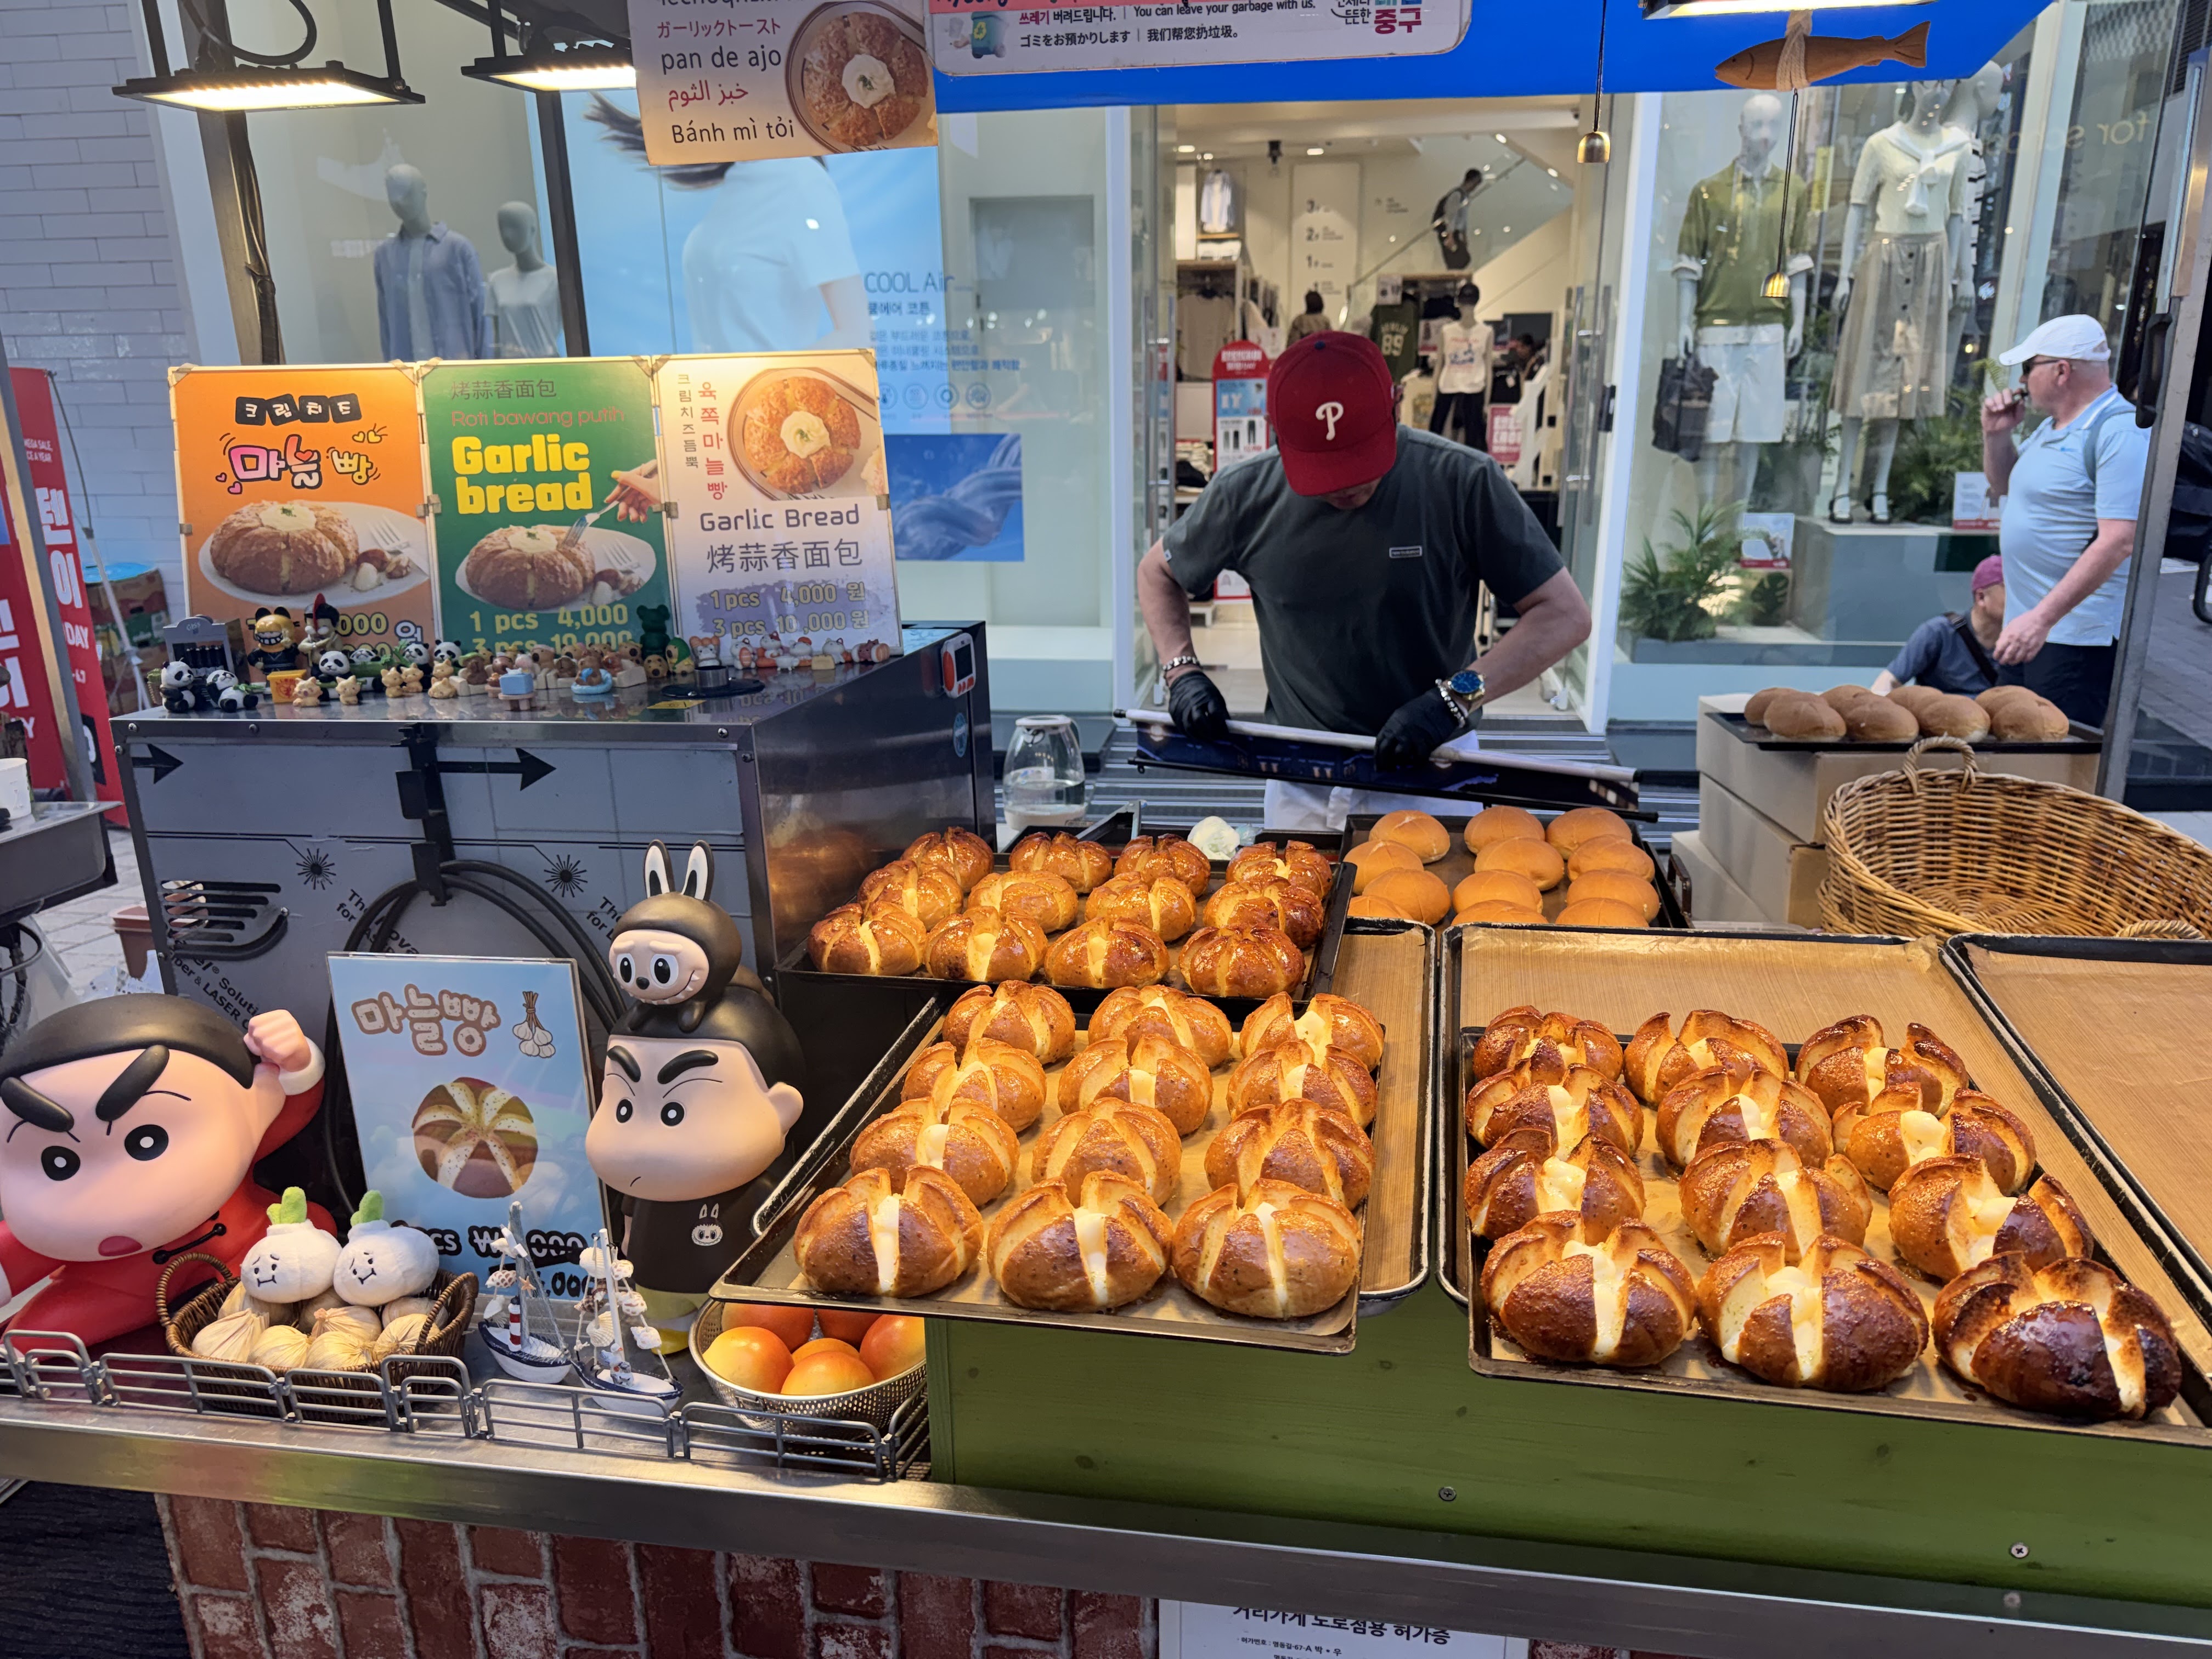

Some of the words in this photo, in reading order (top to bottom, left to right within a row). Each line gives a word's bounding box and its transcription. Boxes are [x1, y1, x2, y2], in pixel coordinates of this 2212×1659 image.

[1019, 10, 1049, 25] 쓰레기
[1053, 7, 1116, 24] 버려드립니다.
[1134, 6, 1151, 17] You
[1155, 7, 1173, 16] can
[1177, 4, 1203, 15] leave
[1206, 3, 1229, 15] your
[1232, 1, 1273, 14] garbage
[1277, 0, 1297, 10] with
[1302, 0, 1316, 9] us.
[1374, 8, 1421, 34] 중구
[657, 18, 781, 38] ガーリックトースト
[1020, 31, 1130, 48] ゴミをお預かりします
[1147, 25, 1238, 42] 我们帮您扔垃圾。
[662, 51, 702, 75] pan
[712, 45, 739, 68] de
[748, 45, 781, 72] ajo
[668, 80, 711, 112] الثوم
[717, 83, 749, 106] خبز
[672, 121, 725, 144] Bánh
[733, 117, 758, 141] mì
[765, 115, 794, 139] tỏi
[864, 272, 919, 294] COOL
[923, 272, 955, 294] Air
[1381, 332, 1404, 357] 89
[451, 379, 557, 400] 烤蒜香面包
[245, 399, 352, 421] 크림치즈
[451, 410, 489, 427] Roti
[493, 409, 573, 428] bawang
[578, 406, 624, 427] putih
[1316, 401, 1344, 441] P
[451, 433, 590, 475] Garlic
[697, 381, 729, 500] 육쪽마늘빵
[455, 472, 594, 515] bread
[699, 507, 775, 532] Garlic
[785, 504, 860, 529] Bread
[706, 538, 863, 574] 烤蒜香面包
[710, 590, 720, 609] 1
[725, 591, 760, 612] pcs
[780, 583, 837, 607] 4,000
[846, 581, 866, 602] 원
[470, 611, 482, 632] 1
[495, 612, 539, 634] pcs
[557, 603, 629, 630] 4,000
[713, 618, 726, 638] 3
[731, 618, 766, 639] pcs
[850, 609, 870, 629] 원
[336, 902, 356, 922] for
[586, 911, 607, 930] for
[194, 976, 202, 986] &
[203, 982, 241, 1021] LASER
[351, 984, 502, 1057] 마늘빵
